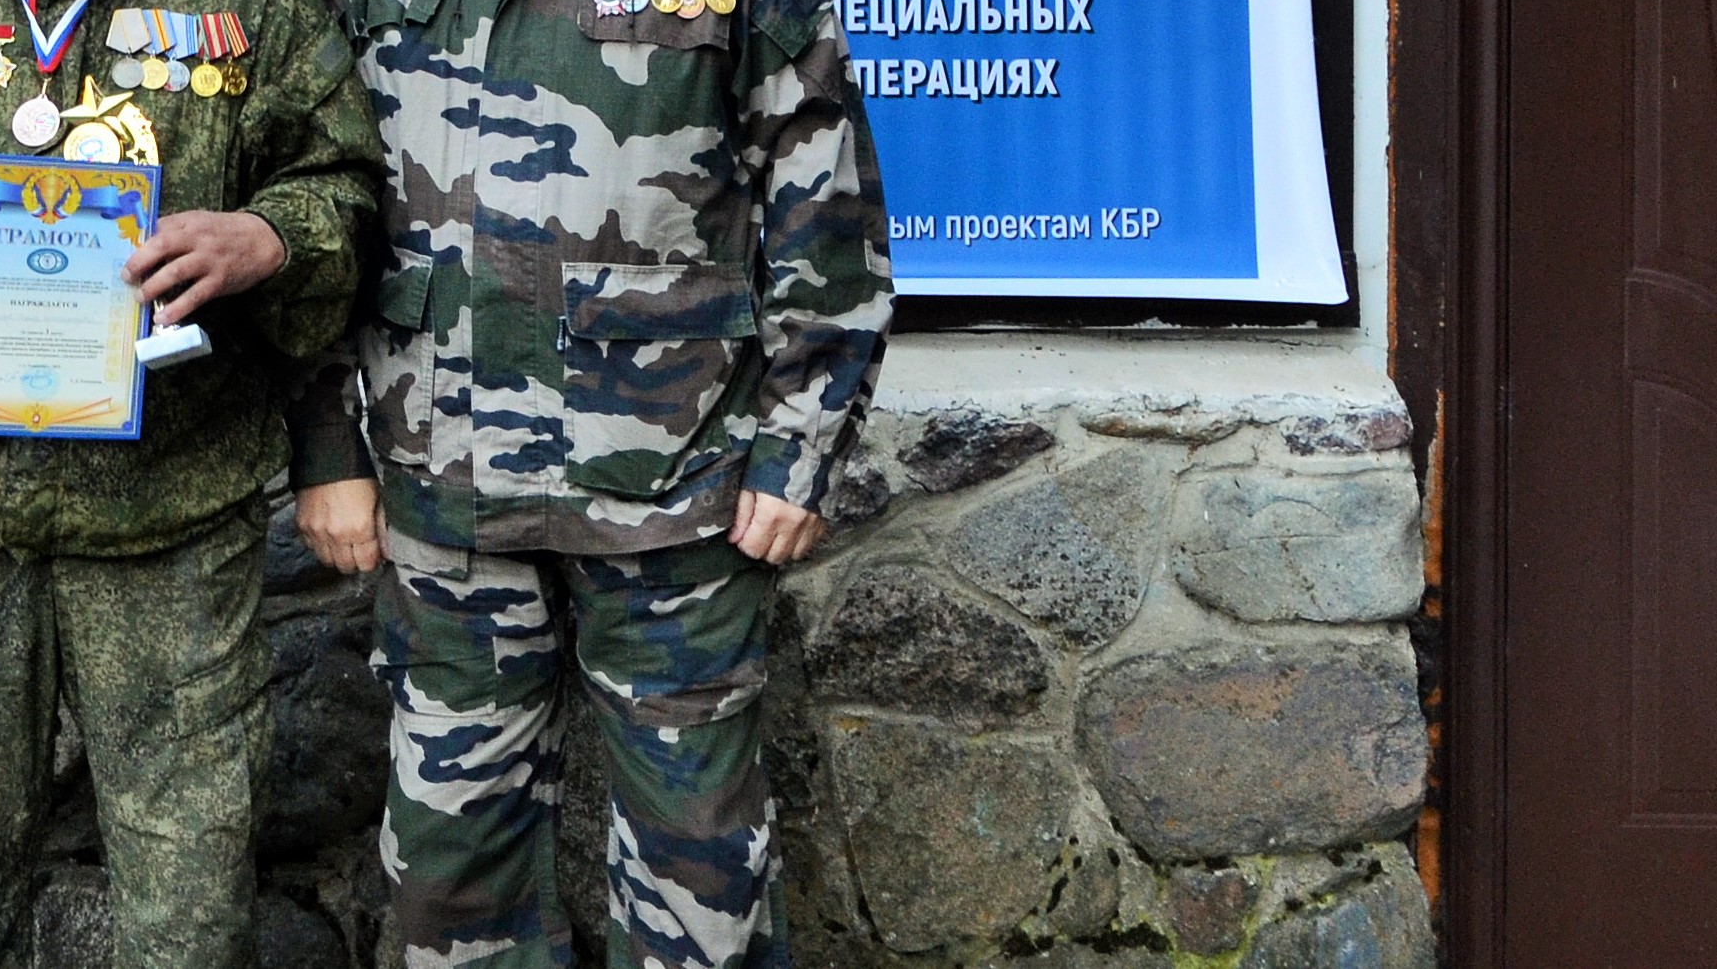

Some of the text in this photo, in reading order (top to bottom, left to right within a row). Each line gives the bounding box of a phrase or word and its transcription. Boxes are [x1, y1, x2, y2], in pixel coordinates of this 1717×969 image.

[852, 59, 1059, 101] ПЕРАЦИЯХ
[889, 207, 1162, 246] ым проектам КБР
